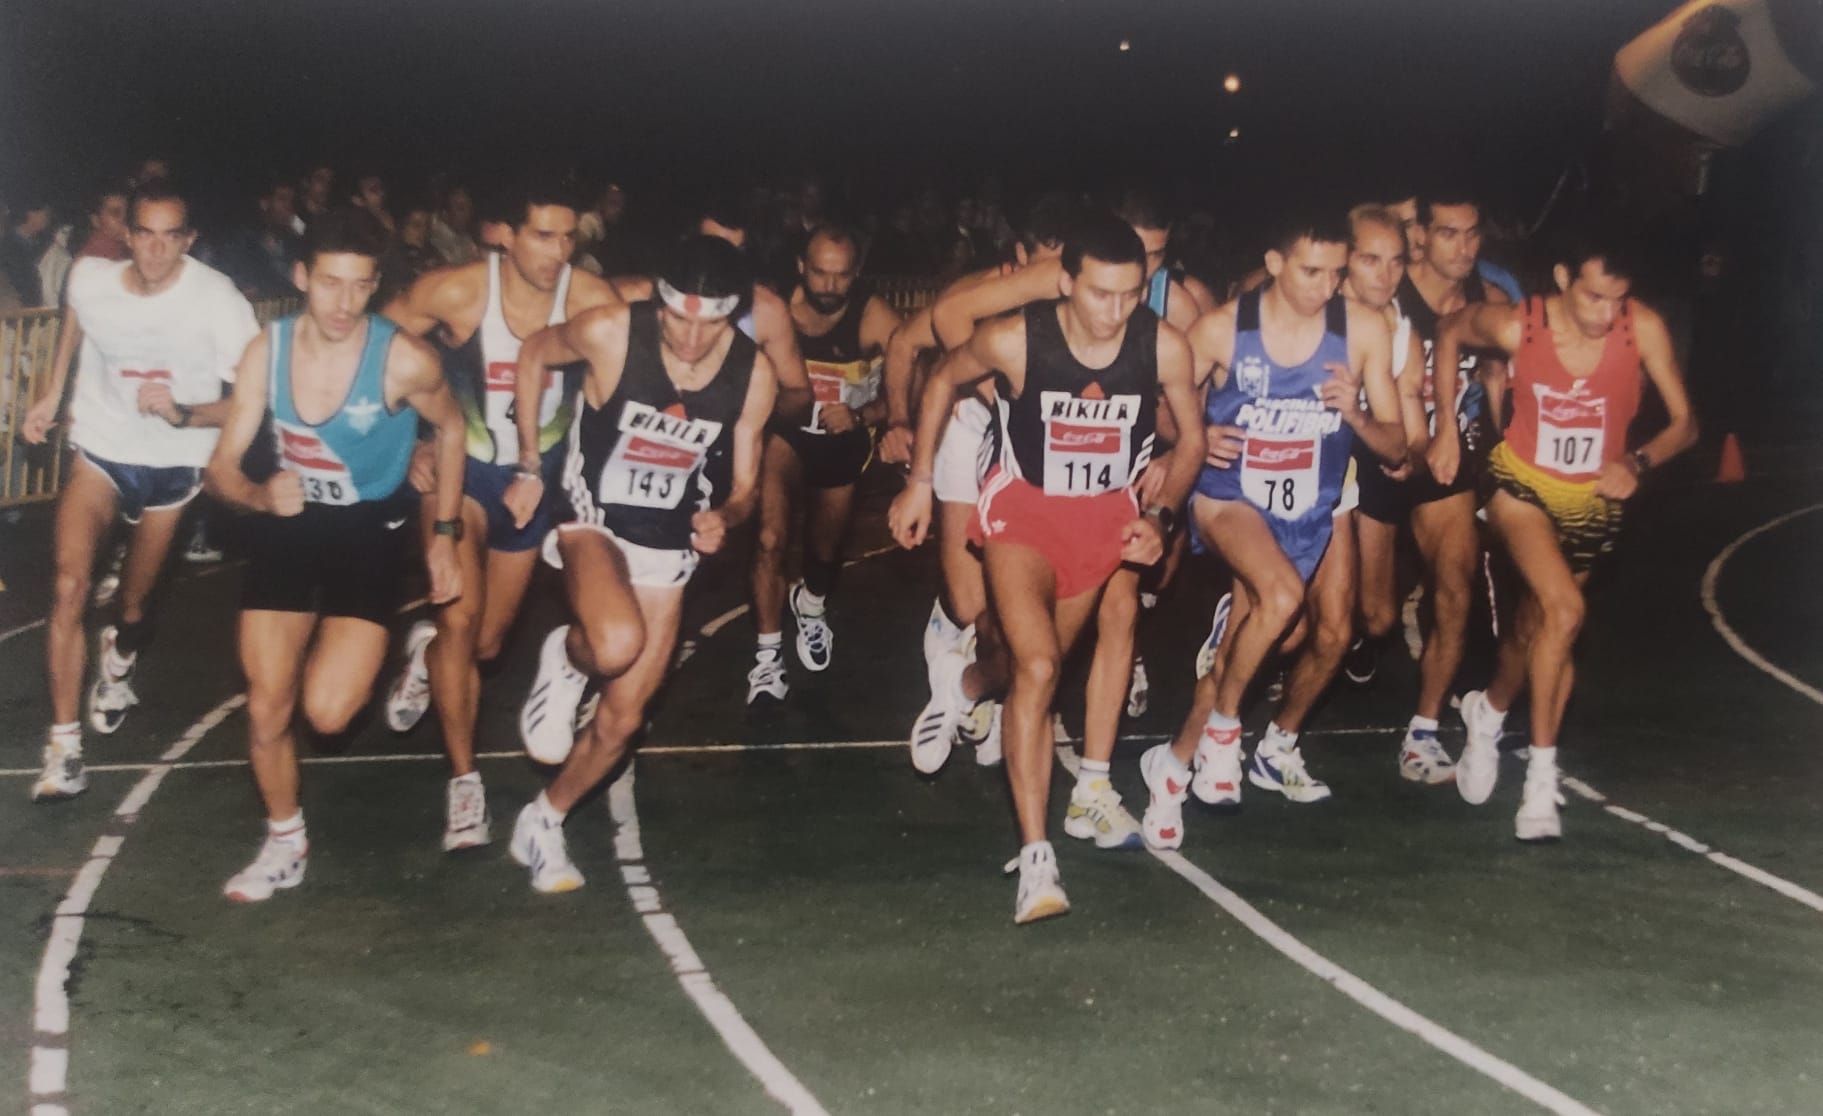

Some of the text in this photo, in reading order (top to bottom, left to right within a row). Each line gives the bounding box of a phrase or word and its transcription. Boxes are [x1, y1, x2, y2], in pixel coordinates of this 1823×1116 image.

[1553, 436, 1595, 465] 107
[627, 468, 675, 499] 143
[1065, 461, 1112, 491] 114
[1264, 477, 1295, 511] 78
